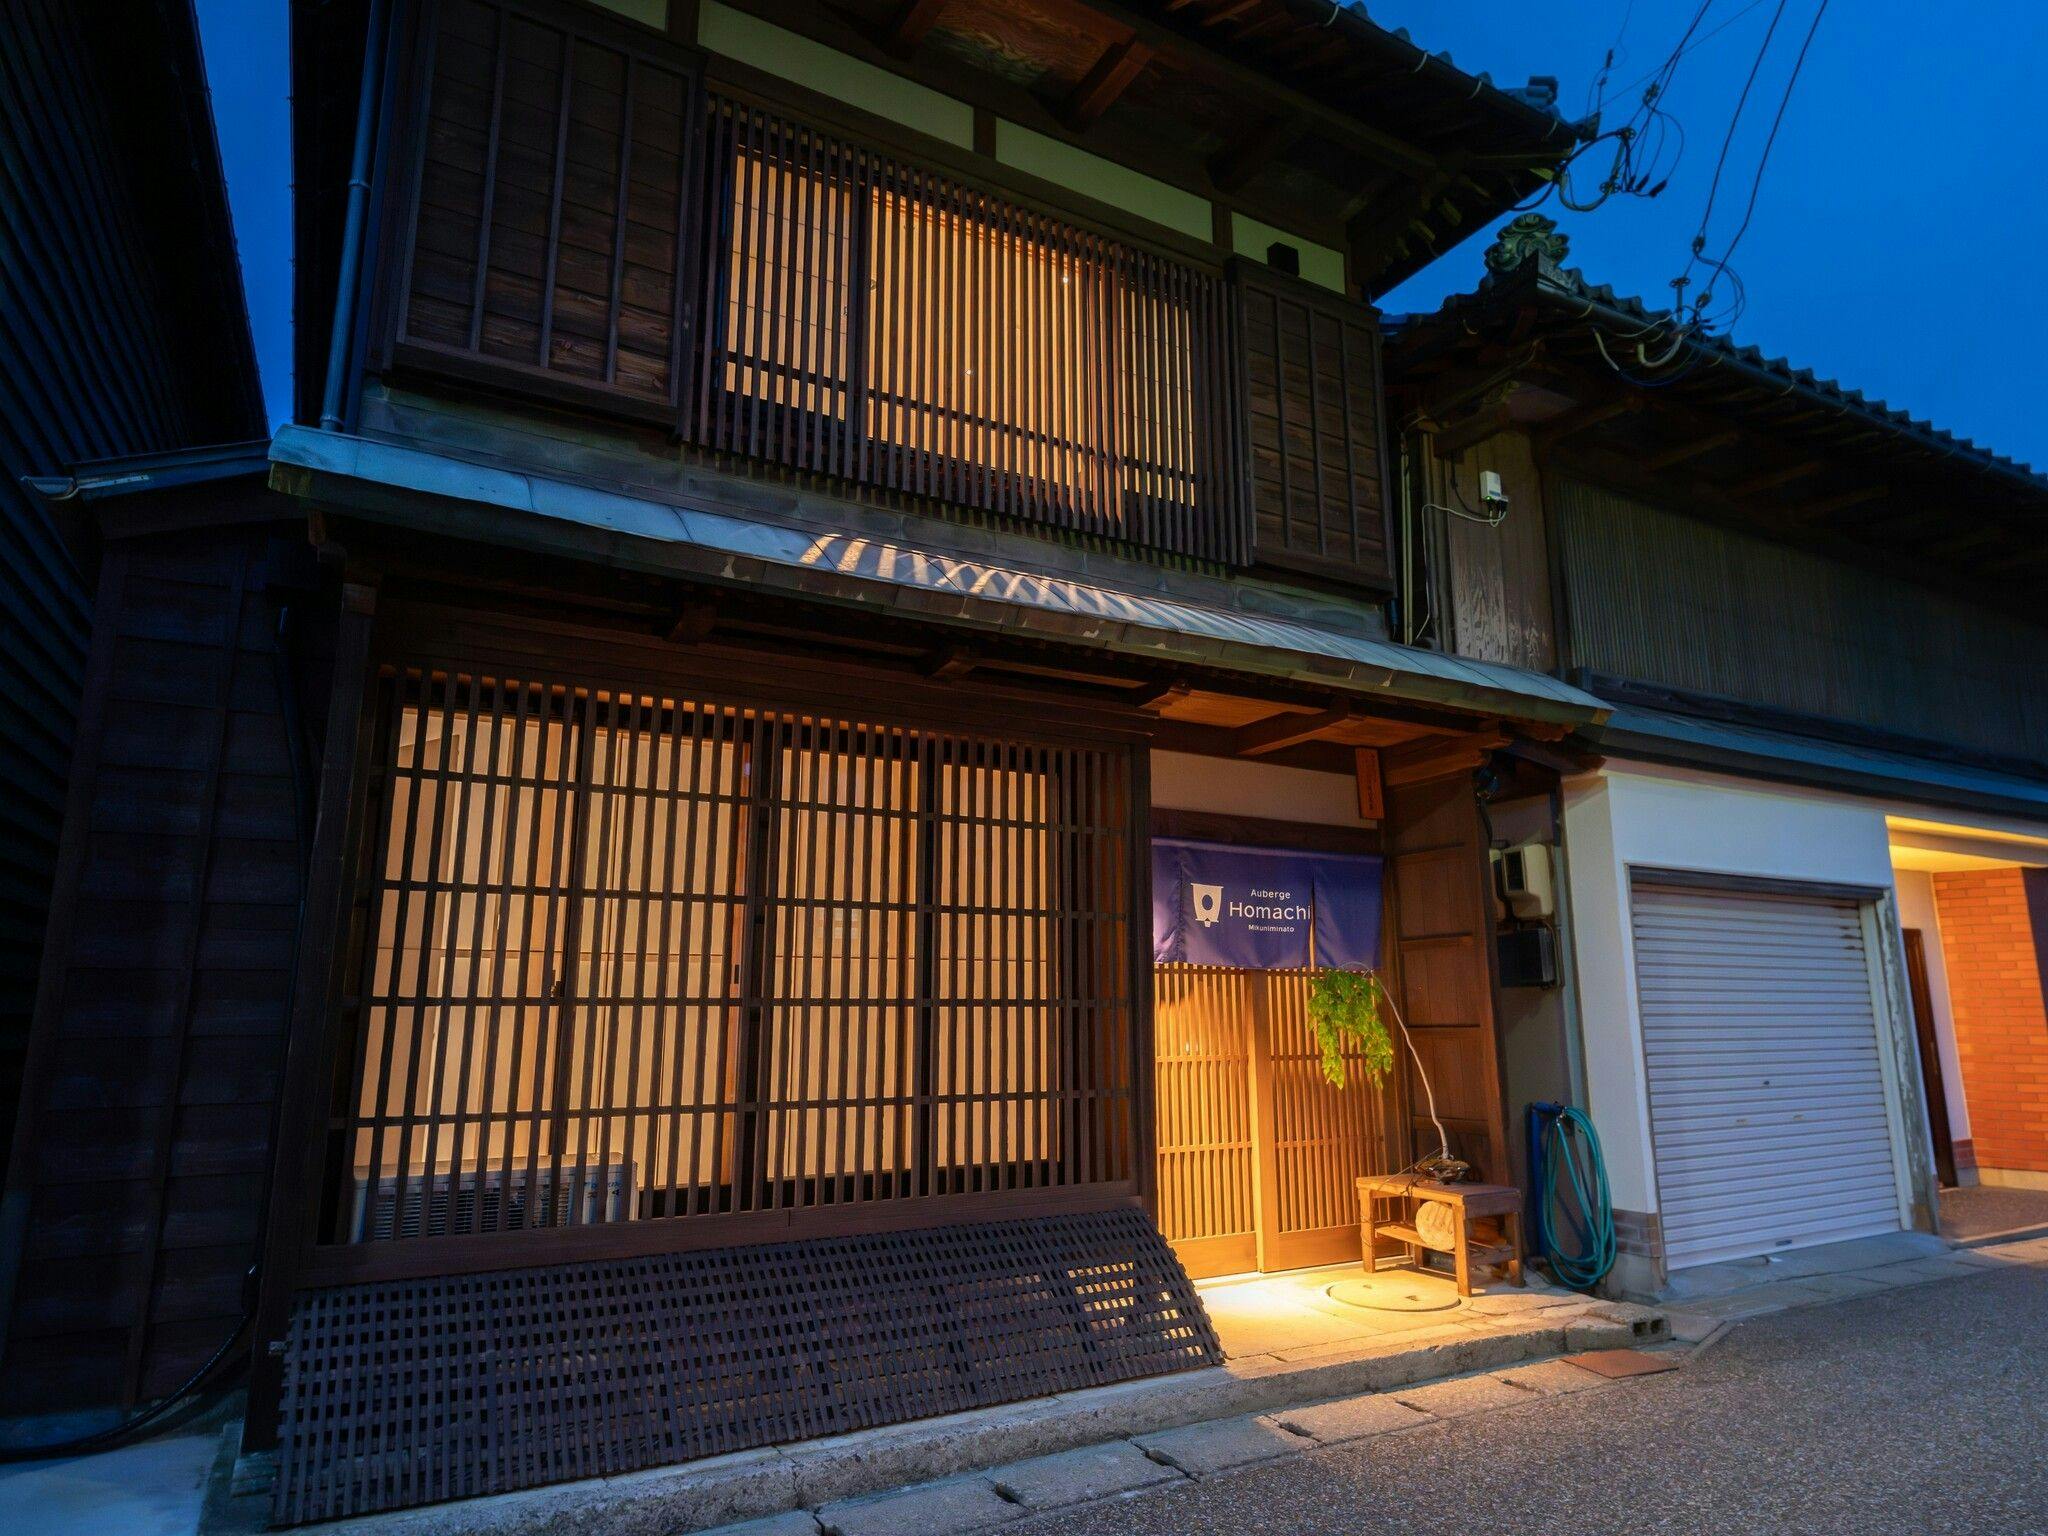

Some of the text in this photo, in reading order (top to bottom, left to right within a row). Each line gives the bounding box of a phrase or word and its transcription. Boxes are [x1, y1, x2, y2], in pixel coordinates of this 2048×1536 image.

[1250, 889, 1291, 901] Auberge
[1229, 901, 1311, 920] Homachi
[1248, 924, 1295, 933] Mikuniminato
